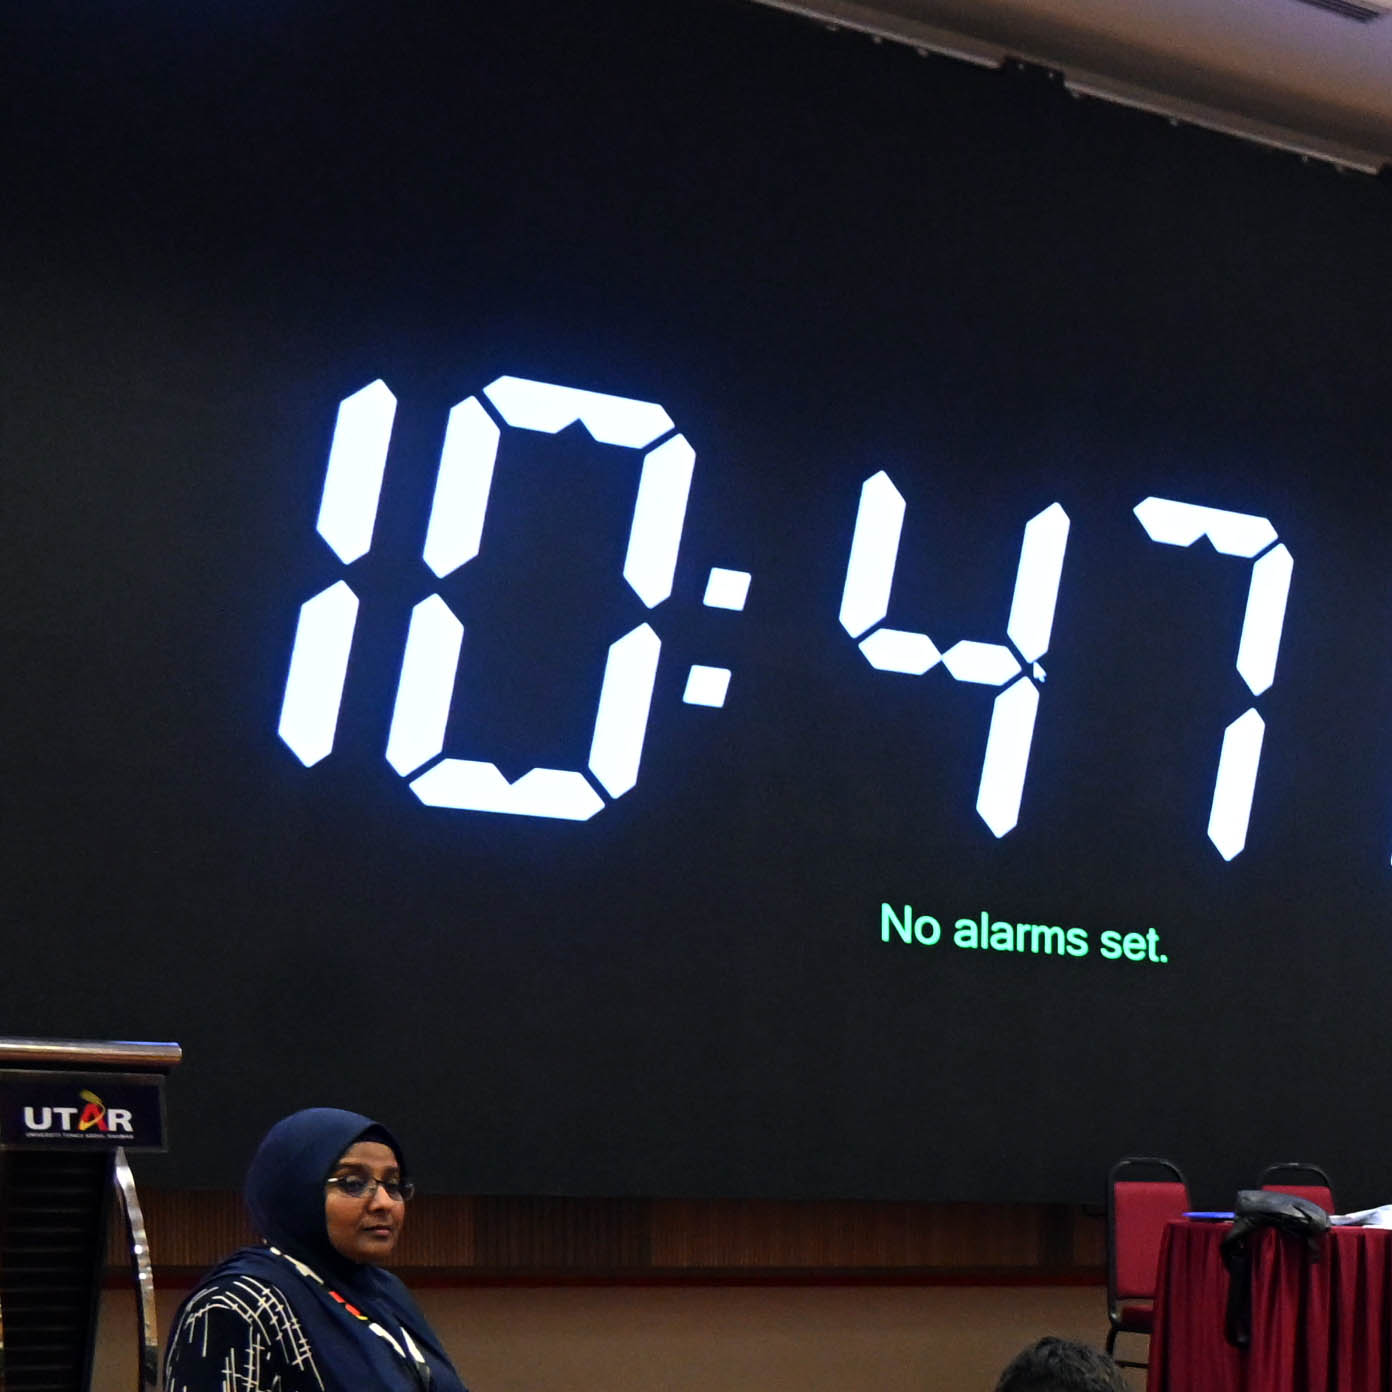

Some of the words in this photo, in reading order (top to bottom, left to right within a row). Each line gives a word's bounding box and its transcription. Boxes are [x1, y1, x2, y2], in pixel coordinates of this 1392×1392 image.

[278, 375, 1295, 862] 10:47
[881, 902, 941, 946] No
[953, 911, 1089, 957] alarms
[1100, 927, 1169, 963] set.
[24, 1096, 134, 1132] UTAR
